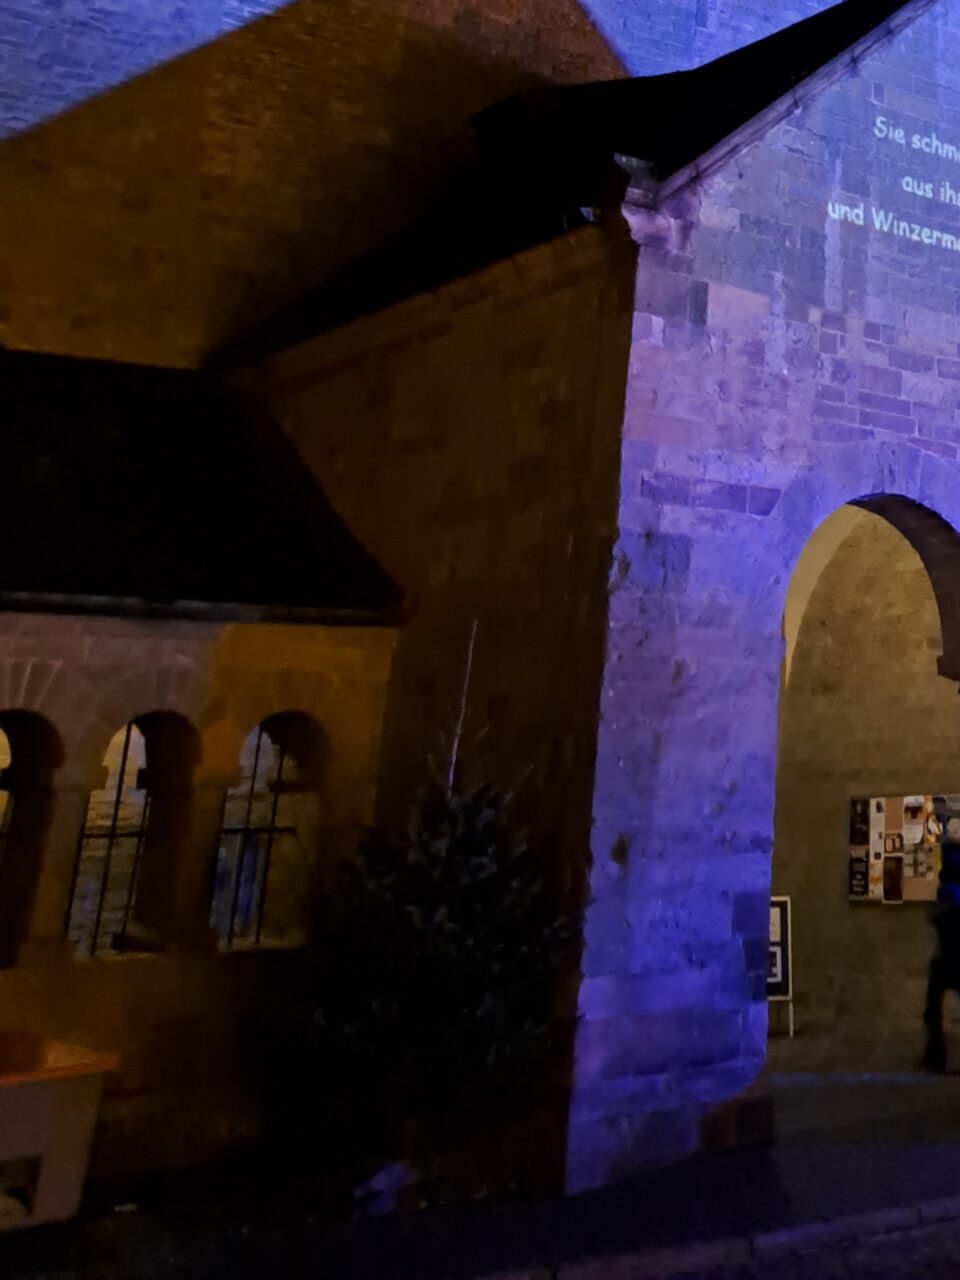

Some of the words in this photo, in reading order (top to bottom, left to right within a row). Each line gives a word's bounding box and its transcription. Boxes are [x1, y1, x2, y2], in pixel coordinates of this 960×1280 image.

[873, 115, 905, 144] Sie
[902, 175, 934, 199] aus
[827, 201, 865, 225] und
